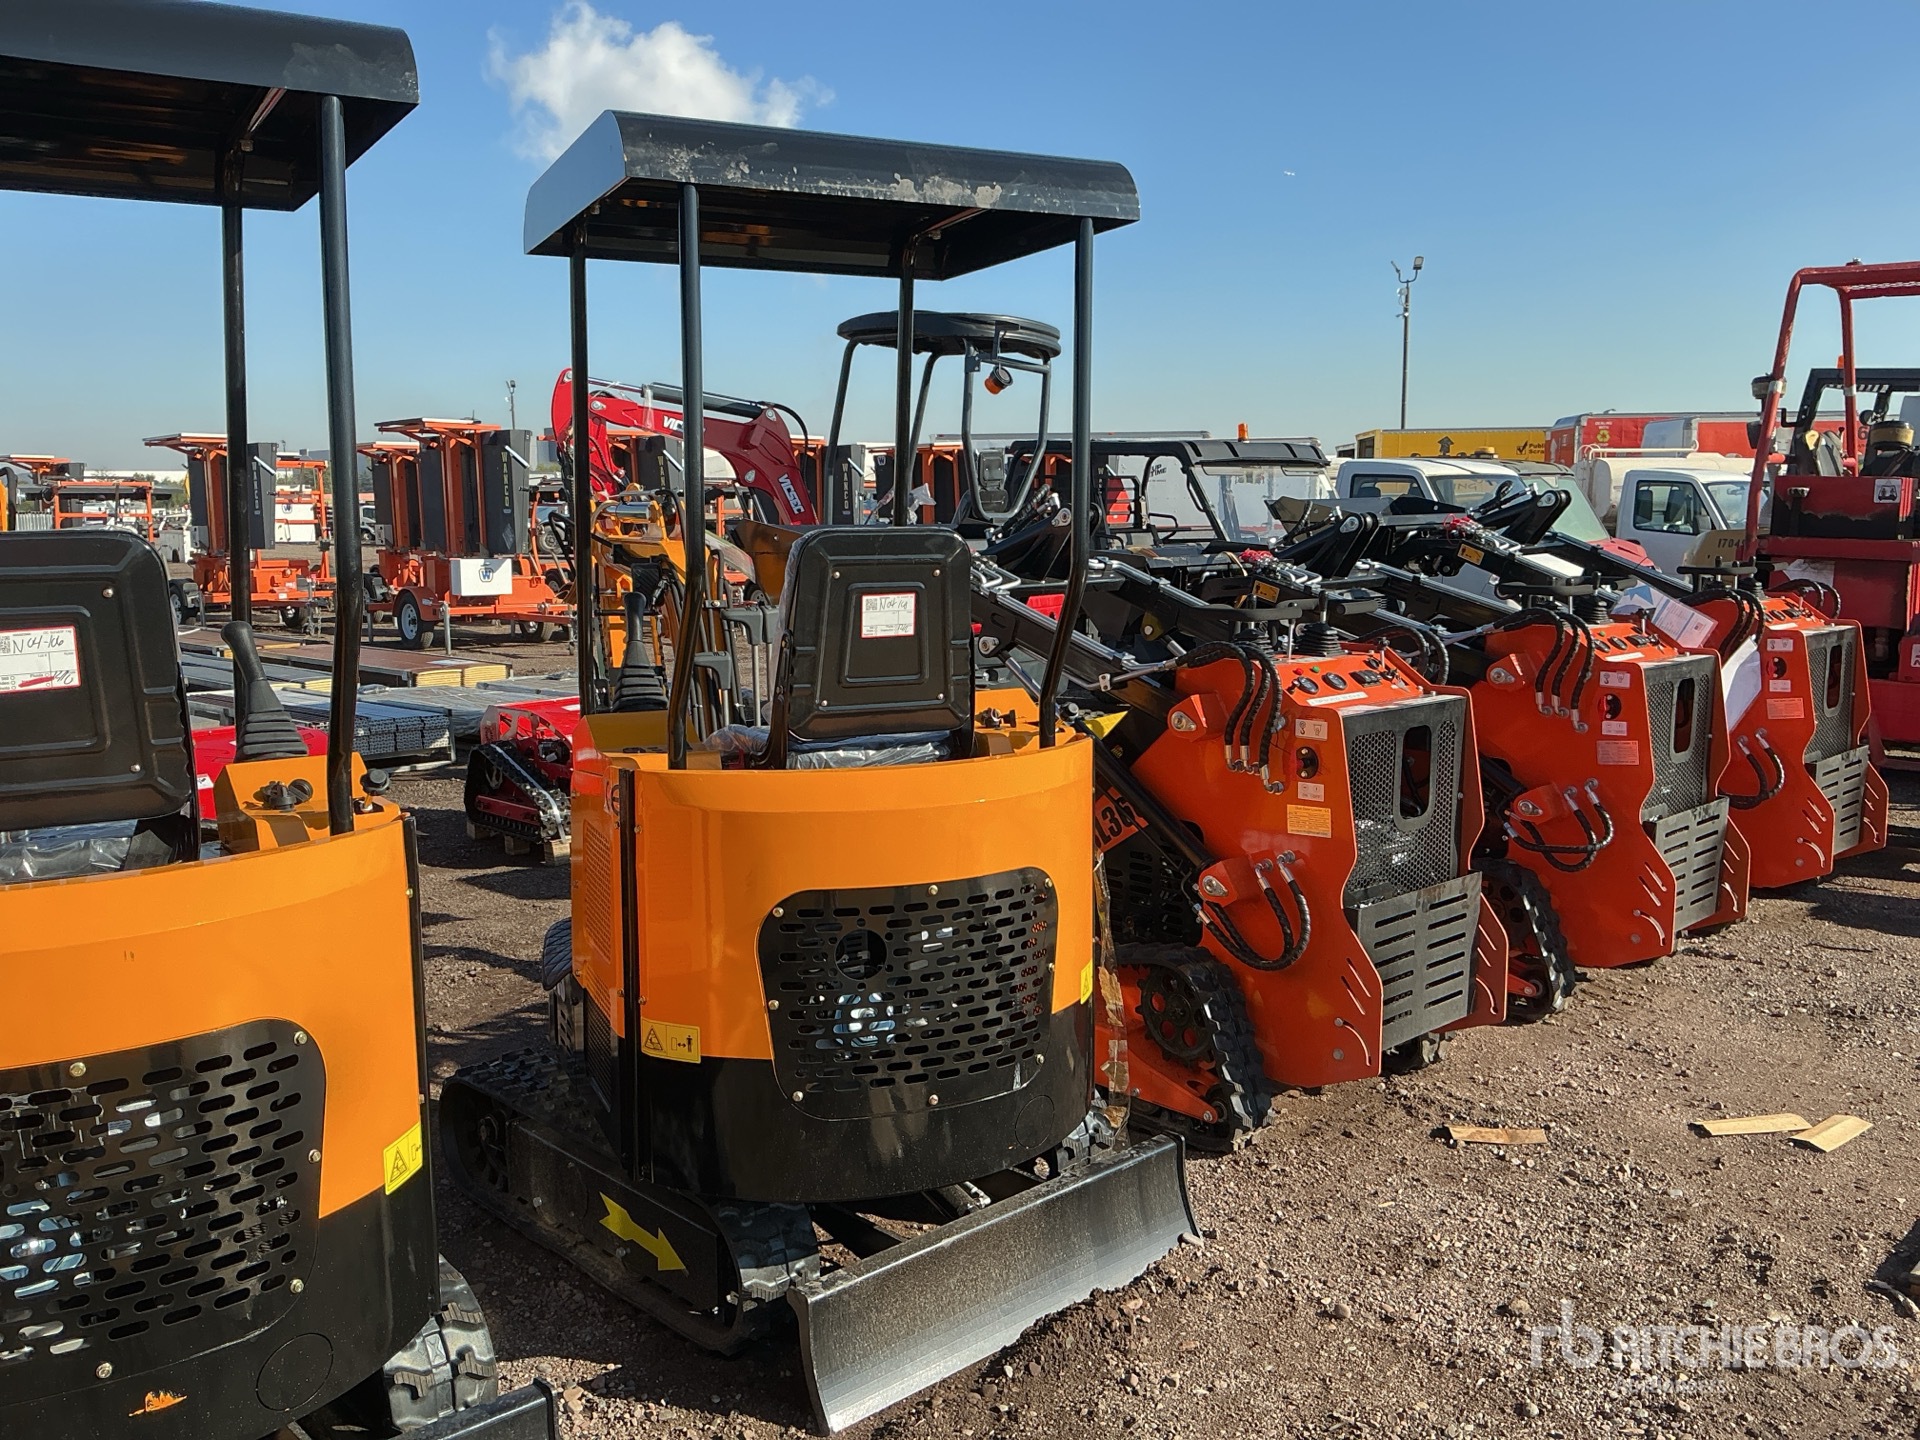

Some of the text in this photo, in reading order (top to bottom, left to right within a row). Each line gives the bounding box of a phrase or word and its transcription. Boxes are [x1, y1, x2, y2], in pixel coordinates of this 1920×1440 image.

[501, 451, 510, 507] WANCO
[657, 455, 666, 490] WAN
[779, 473, 805, 514] VICSEC
